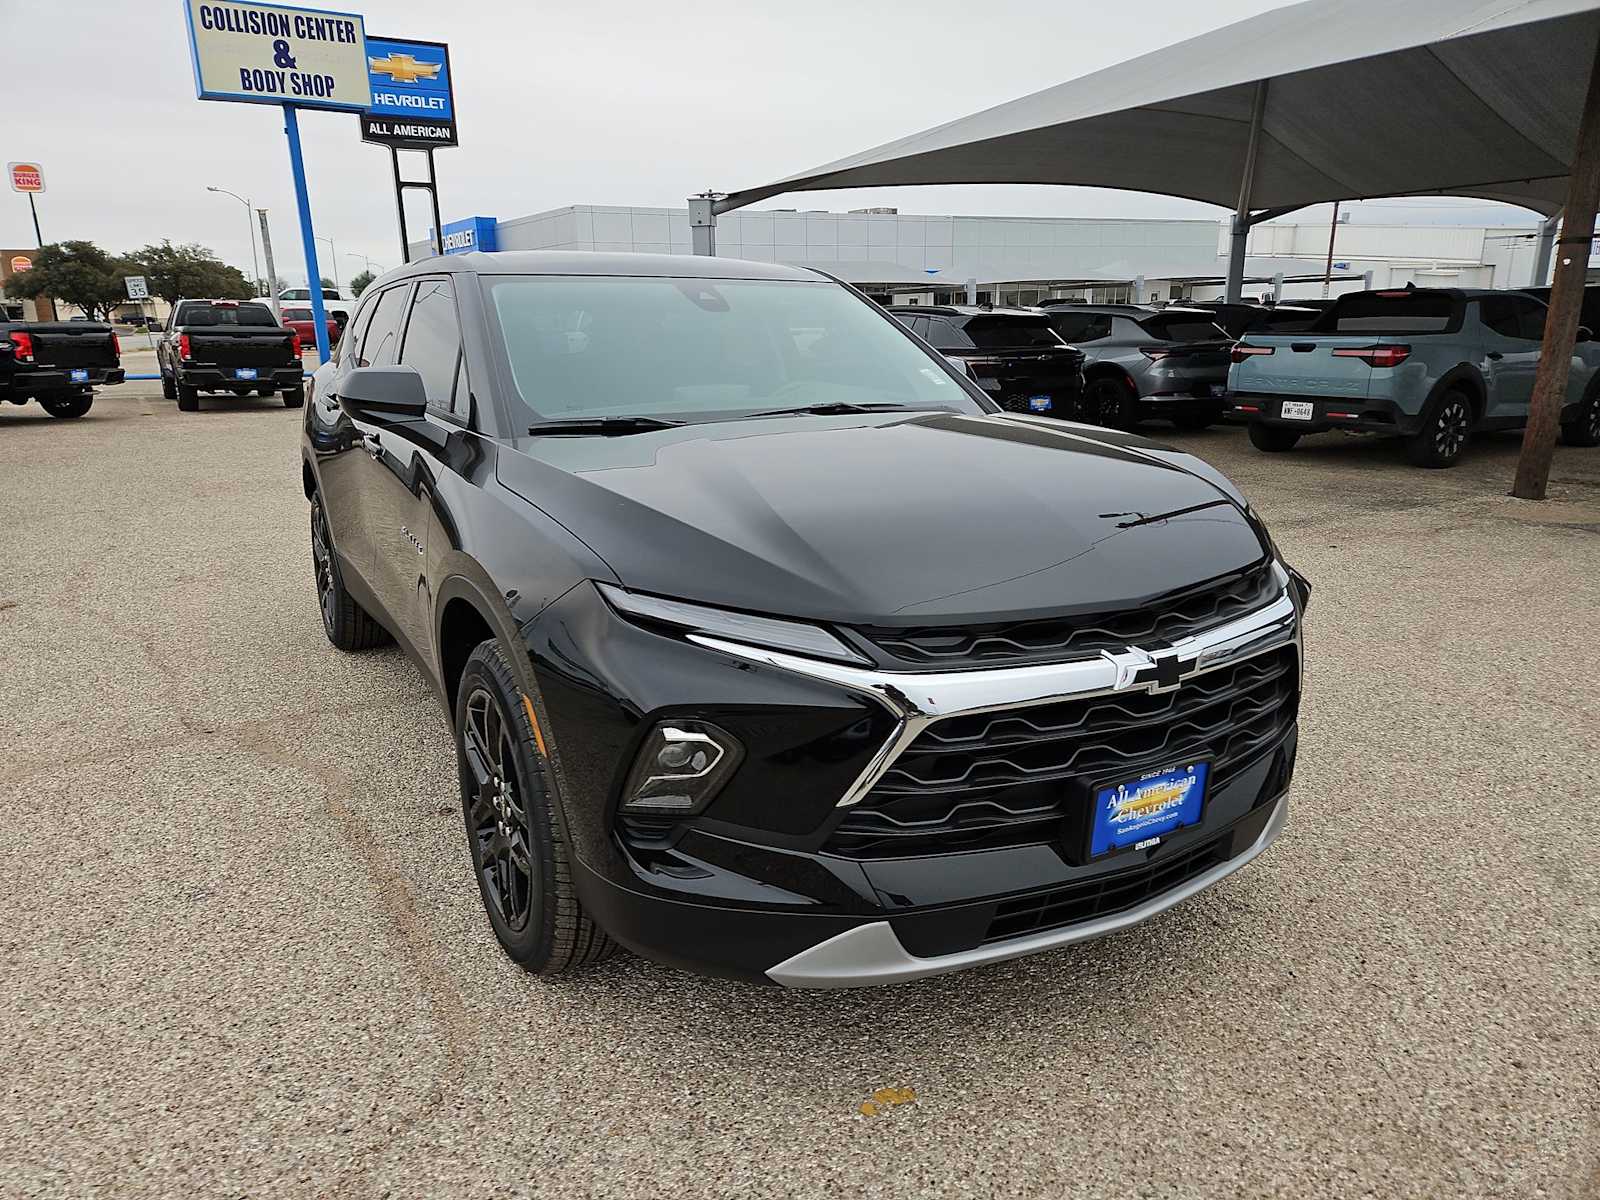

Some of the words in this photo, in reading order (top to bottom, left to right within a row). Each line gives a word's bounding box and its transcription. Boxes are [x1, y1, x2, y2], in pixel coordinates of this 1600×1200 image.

[200, 5, 291, 37] COLLISION
[294, 18, 356, 43] CENTER
[273, 40, 297, 69] &
[240, 68, 286, 93] BODY
[291, 72, 335, 97] SHOP
[374, 92, 446, 110] HEVROLET
[369, 123, 391, 135] ALL
[393, 124, 450, 139] AMERICAN
[15, 178, 40, 186] KING
[130, 287, 146, 296] 35
[1106, 790, 1129, 809] All
[1136, 775, 1196, 800] American
[1117, 795, 1185, 823] Chevrolet
